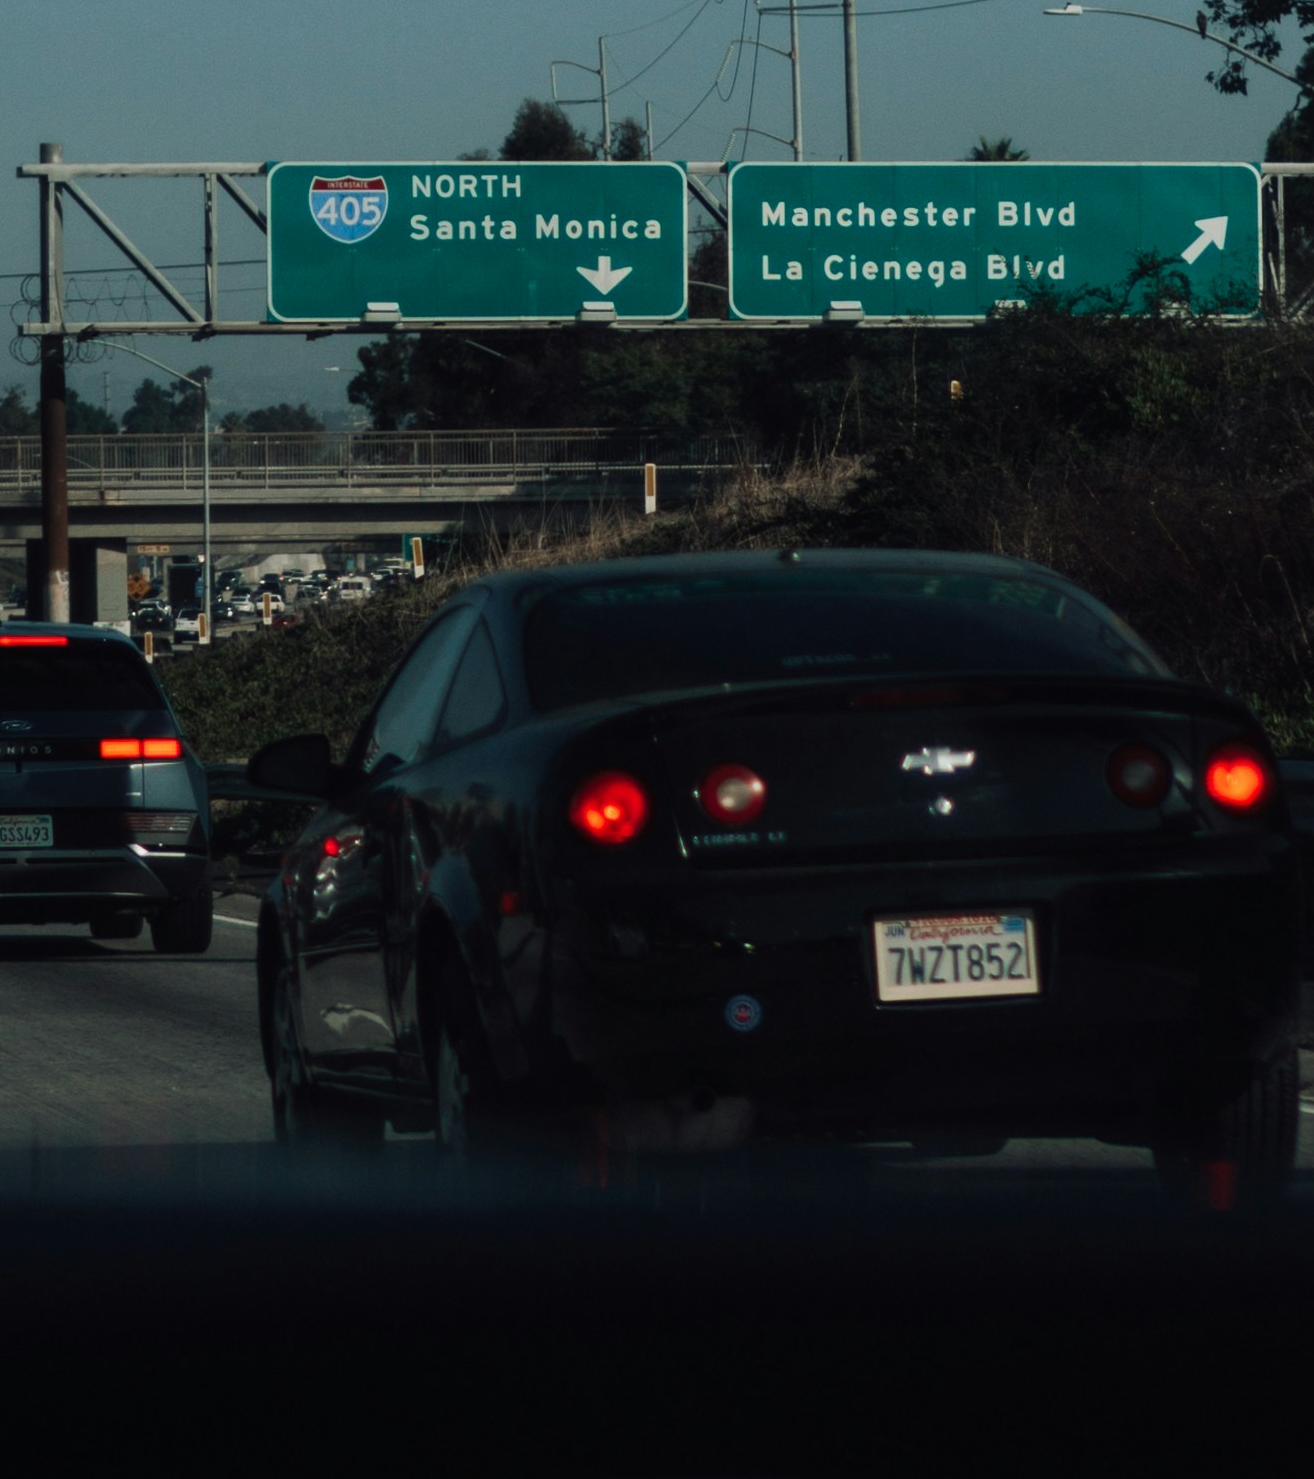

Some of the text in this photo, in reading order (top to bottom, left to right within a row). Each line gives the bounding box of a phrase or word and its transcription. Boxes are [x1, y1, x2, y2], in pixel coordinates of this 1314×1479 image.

[327, 181, 369, 189] INTERSTATE
[412, 174, 521, 198] NORTH
[317, 196, 382, 226] 405
[762, 201, 1075, 227] Manchester Blvd
[410, 213, 662, 240] Santa Monica
[762, 254, 1066, 288] La Cienega Blvd
[885, 925, 905, 937] JUN
[910, 925, 1003, 943] California
[888, 942, 1026, 986] 7WZT852
